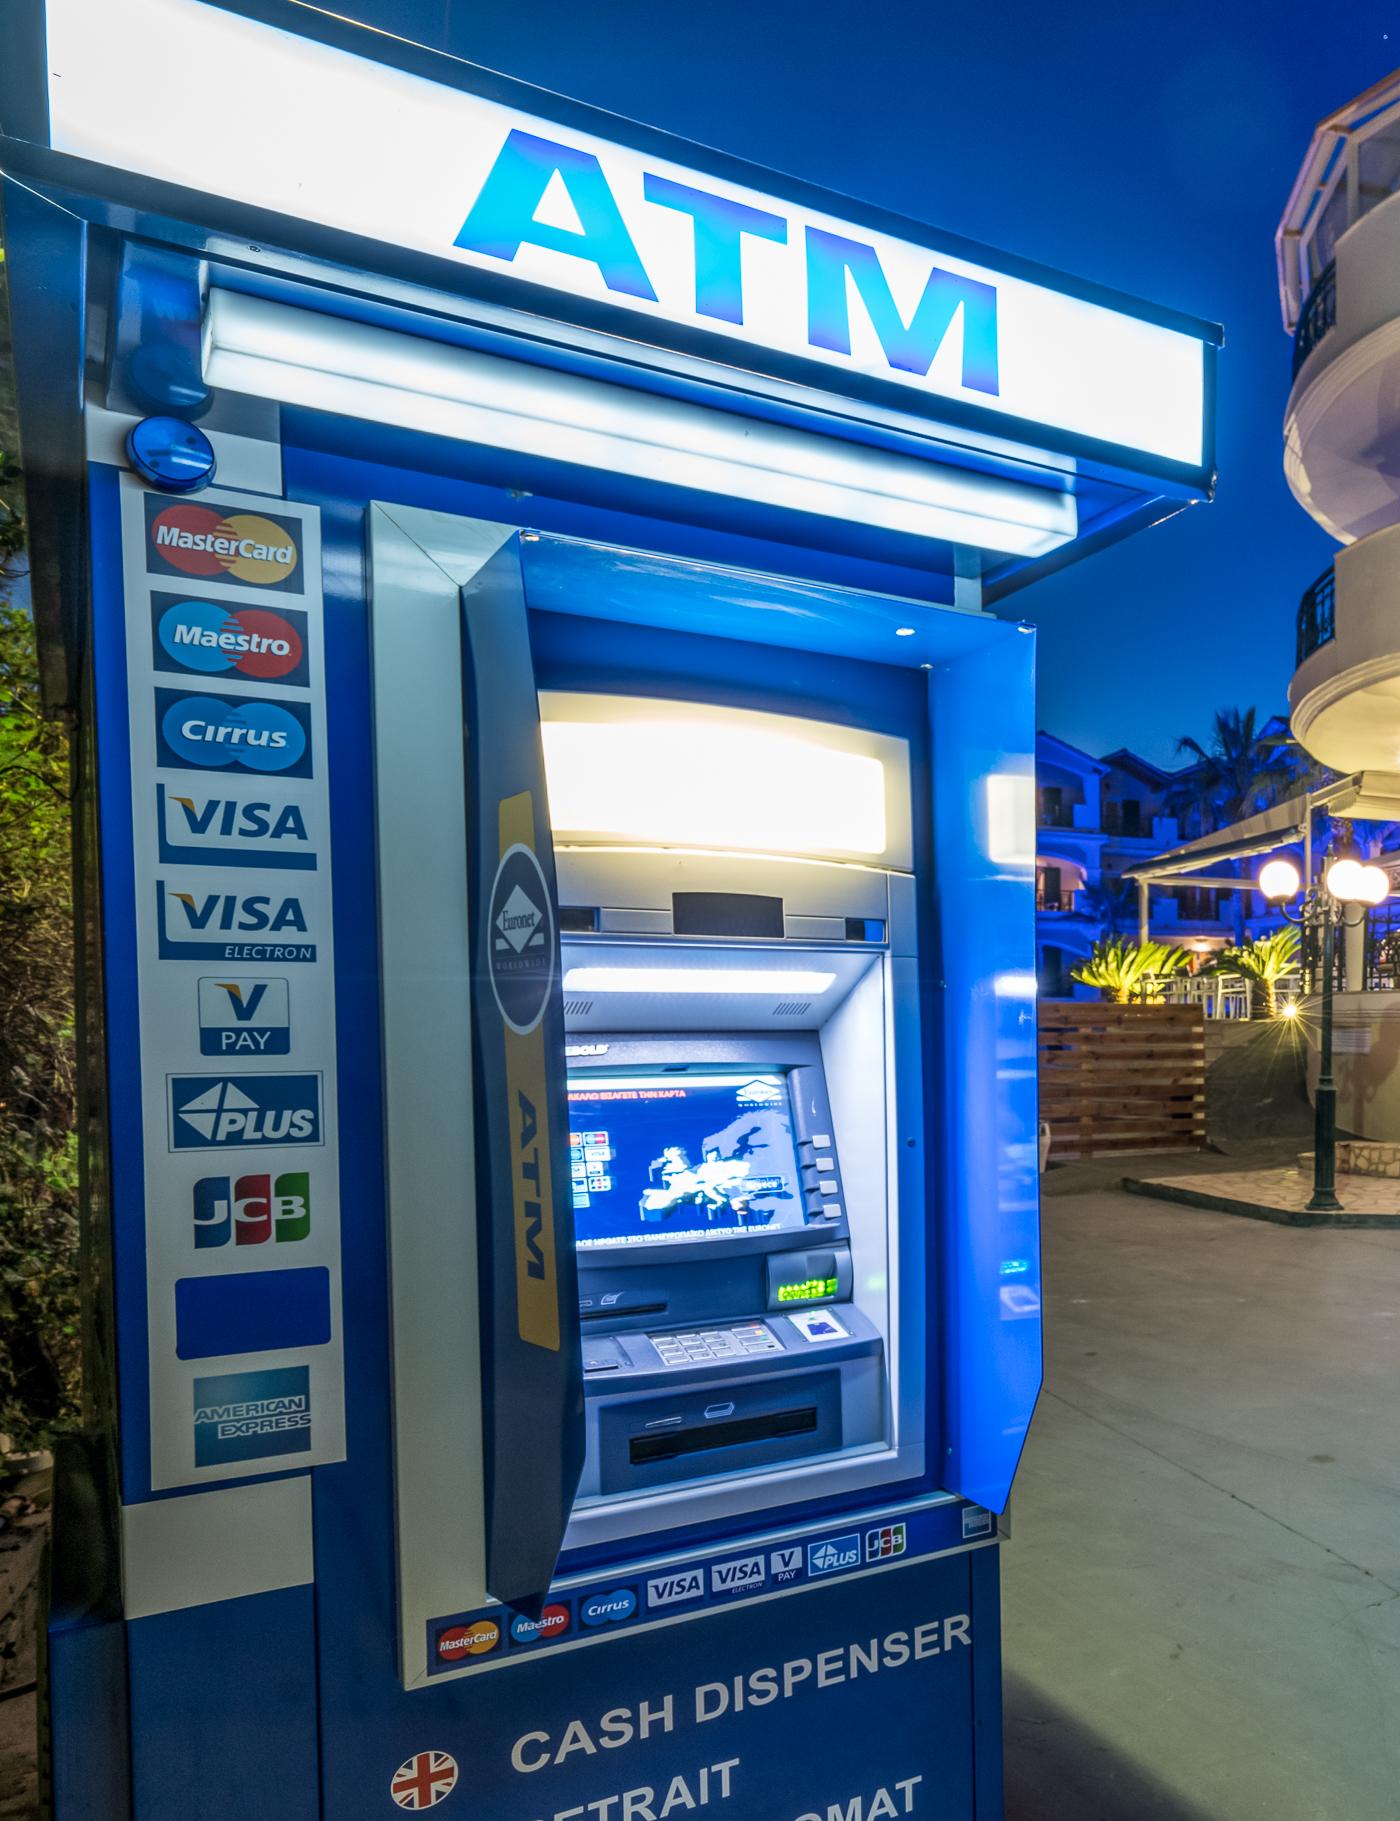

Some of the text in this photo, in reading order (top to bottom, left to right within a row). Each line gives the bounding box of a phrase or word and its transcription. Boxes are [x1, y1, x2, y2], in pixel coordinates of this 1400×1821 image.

[453, 128, 999, 396] ATM
[156, 525, 293, 564] MasterCard
[174, 624, 290, 656] Maestro
[181, 720, 287, 748] Cirrus
[168, 796, 308, 840] VISA
[167, 893, 308, 932] VISA
[502, 910, 535, 931] Euronet
[224, 945, 312, 959] ELECTRON
[214, 983, 268, 1021] V
[221, 1031, 271, 1050] PAY
[216, 1108, 315, 1141] PLUS
[518, 1089, 545, 1280] ATM
[194, 1195, 306, 1226] JCB
[195, 1396, 305, 1424] AMERICAN
[218, 1412, 311, 1438] EXPRESS
[870, 1534, 903, 1552] JCB
[776, 1551, 794, 1568] V
[823, 1550, 857, 1569] PLUS
[714, 1561, 761, 1584] VISA
[778, 1570, 796, 1581] PAY
[650, 1575, 700, 1599] VISA
[732, 1582, 762, 1593] ELECTRON
[588, 1599, 629, 1617] Cirrus
[516, 1615, 564, 1633] Maestro
[439, 1630, 497, 1652] MasterCard
[511, 1614, 971, 1773] CASH DISPENSER
